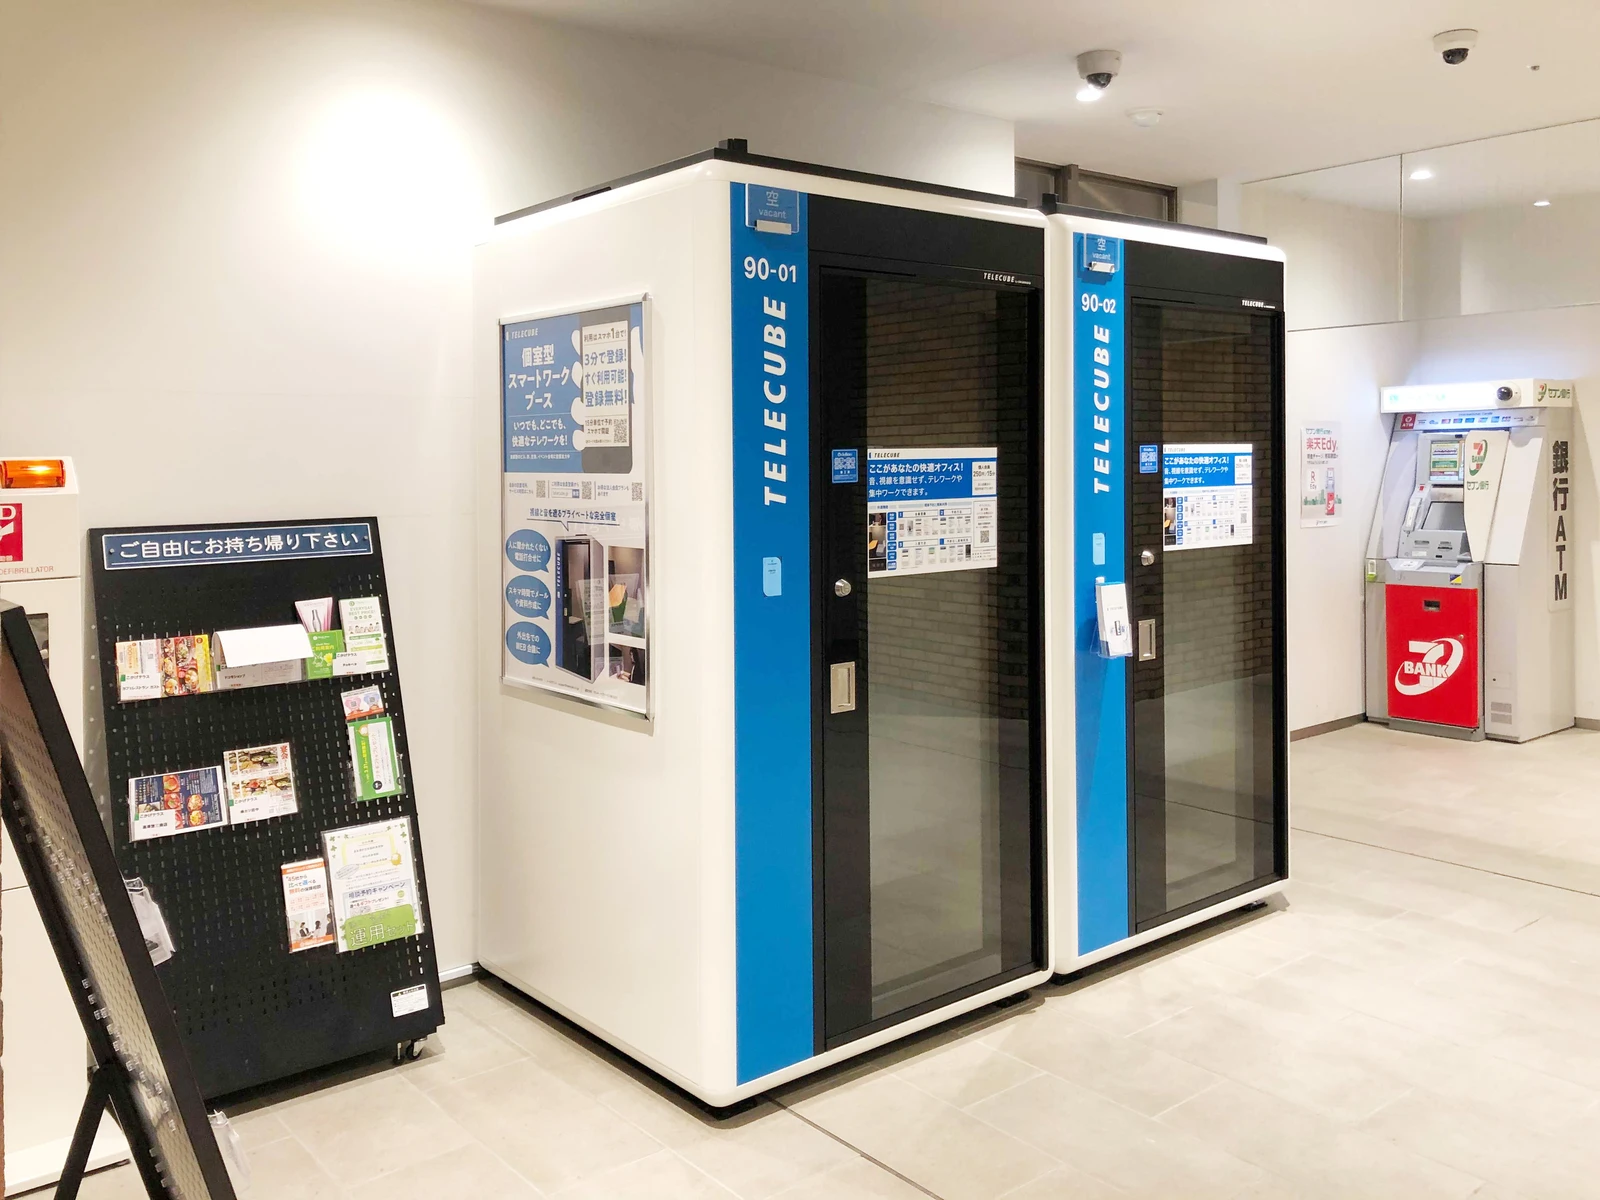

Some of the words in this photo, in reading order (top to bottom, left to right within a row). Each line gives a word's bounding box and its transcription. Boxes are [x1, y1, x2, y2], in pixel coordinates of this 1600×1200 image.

[766, 190, 779, 207] 空
[759, 209, 787, 219] vacant
[1096, 237, 1106, 250] 空
[744, 256, 797, 283] 90-01
[984, 272, 1016, 282] TELECUBE
[1082, 293, 1116, 314] 90-02
[511, 328, 538, 340] TELECUBE
[522, 344, 554, 368] 個室型
[508, 366, 570, 389] スマートワーク
[525, 391, 552, 410] ブース
[586, 388, 627, 408] 登録無料!
[764, 296, 786, 506] TELECUBE
[1094, 324, 1110, 494] TELECUBE
[512, 434, 568, 448] 快適なテレワークを!
[870, 462, 964, 474] ここがあなたの快適オフィス!
[120, 532, 358, 559] ご自由にお持ち帰り下さい
[1404, 660, 1448, 678] BANK
